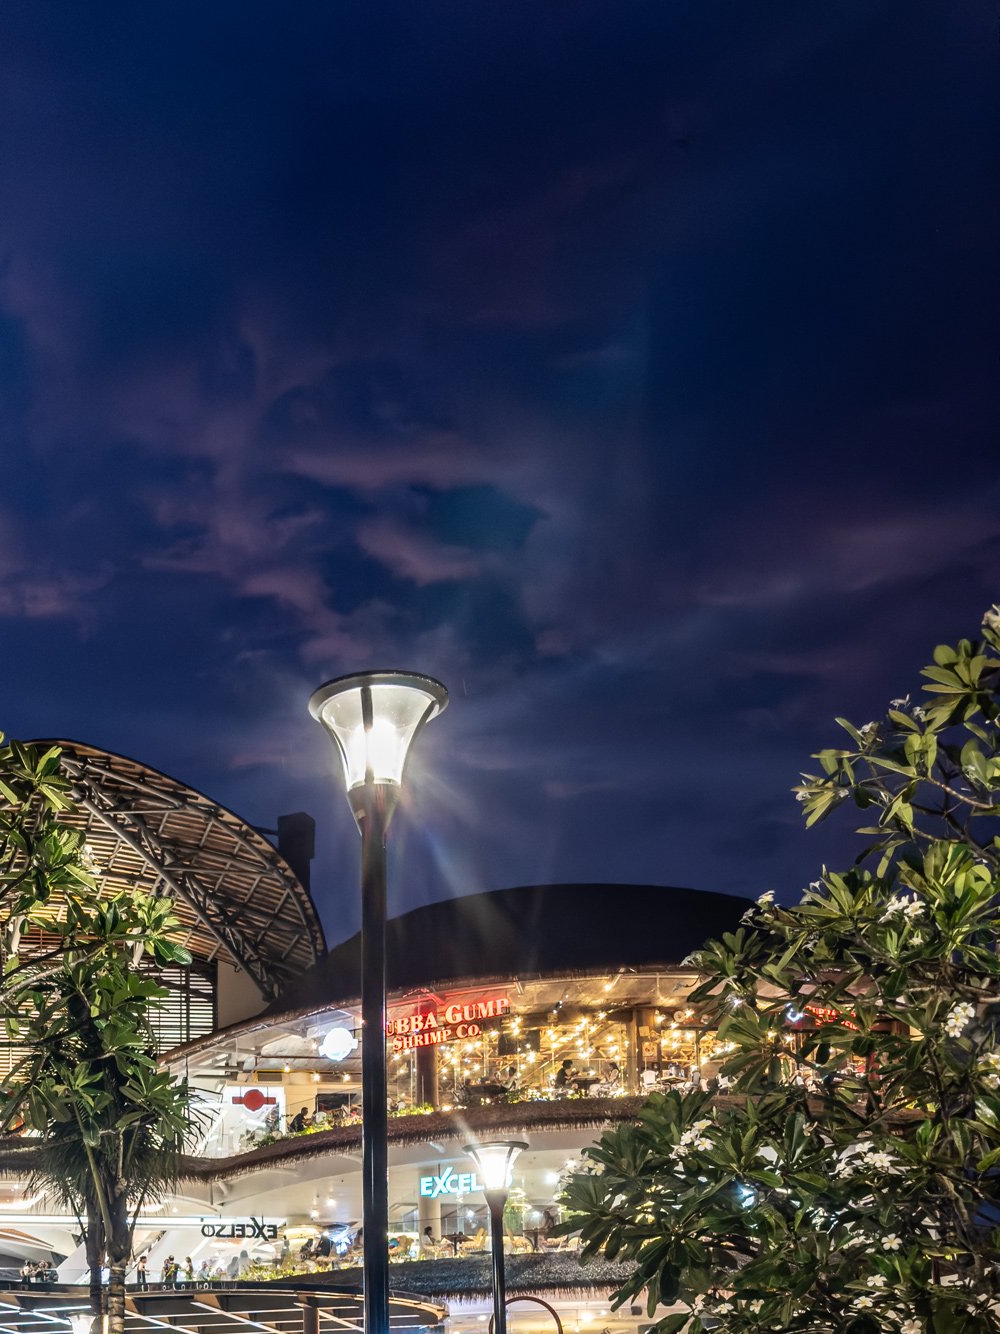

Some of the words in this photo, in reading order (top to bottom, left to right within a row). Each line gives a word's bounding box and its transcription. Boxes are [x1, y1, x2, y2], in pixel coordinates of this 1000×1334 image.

[386, 1012, 438, 1036] UBBA
[445, 998, 509, 1025] GUMP
[392, 1029, 451, 1051] SHRIMP
[456, 1024, 482, 1039] CO.
[420, 1166, 513, 1198] EXCEL
